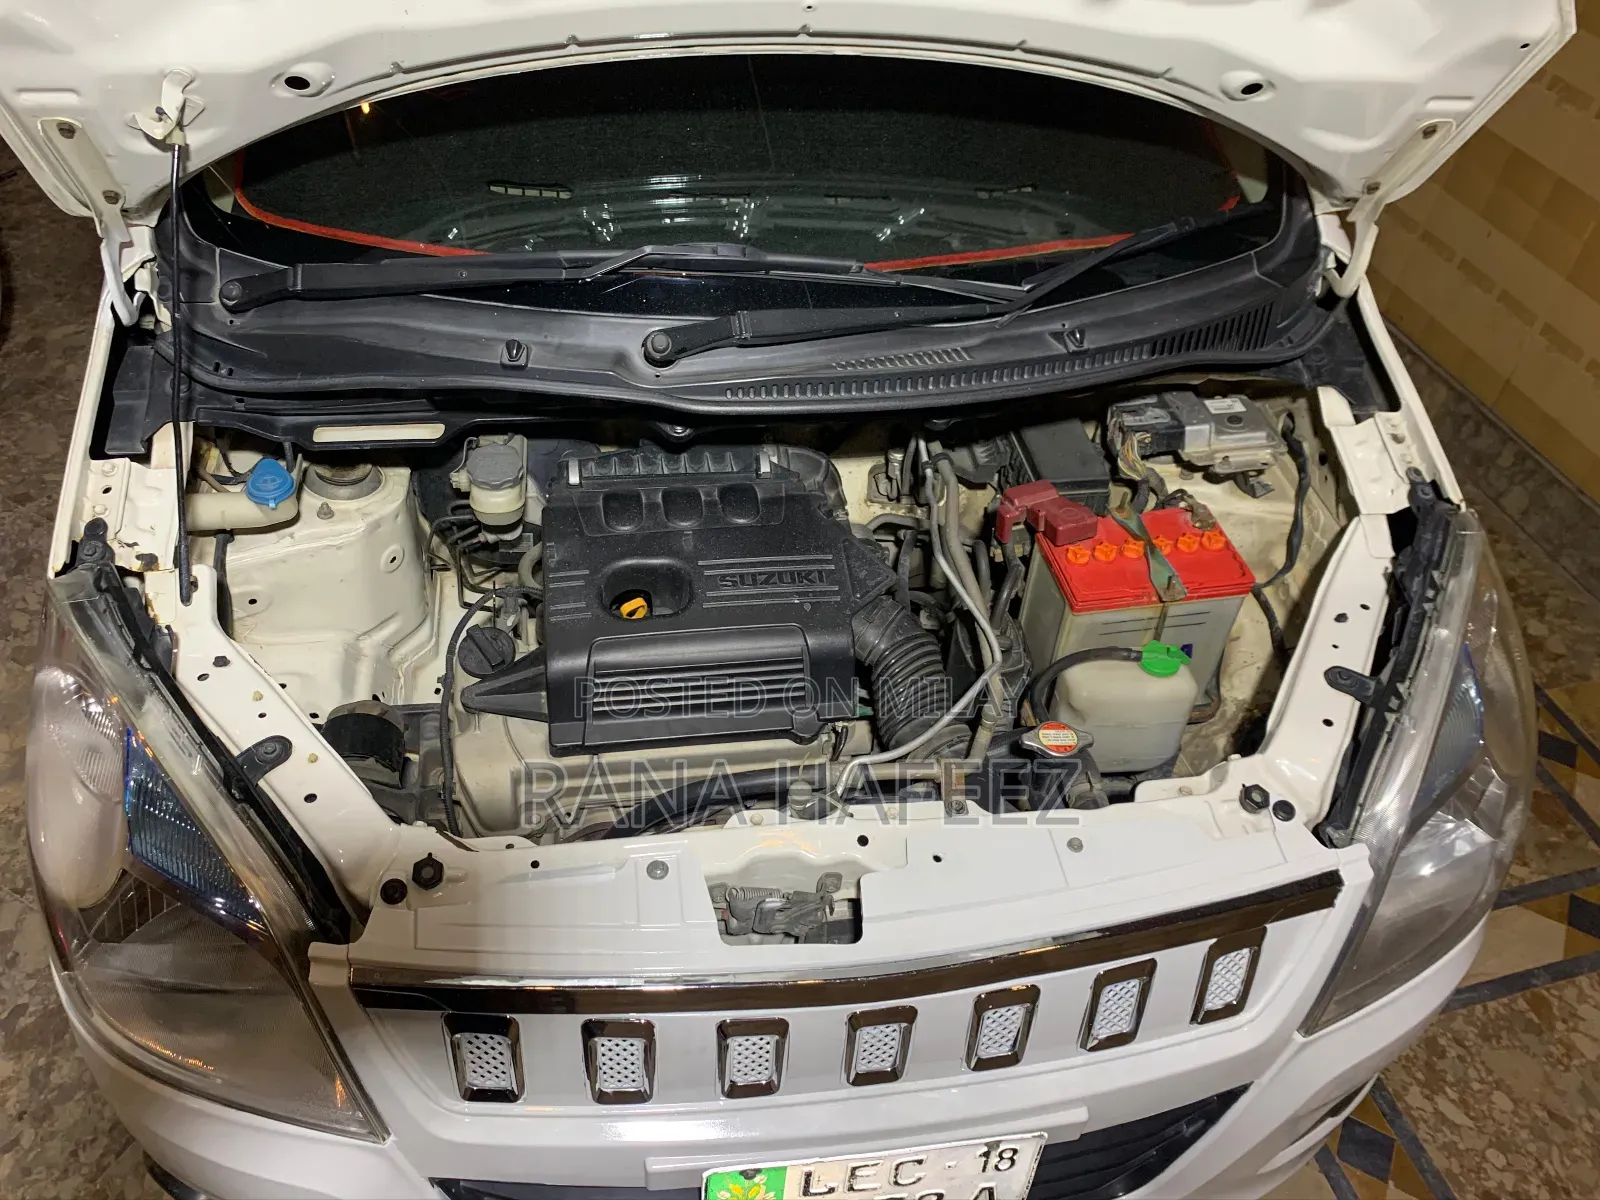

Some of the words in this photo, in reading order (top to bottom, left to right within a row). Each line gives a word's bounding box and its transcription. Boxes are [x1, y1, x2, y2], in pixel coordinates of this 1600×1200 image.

[718, 570, 827, 588] SUZUKI
[801, 1156, 927, 1197] LEC
[976, 1147, 1020, 1173] 18
